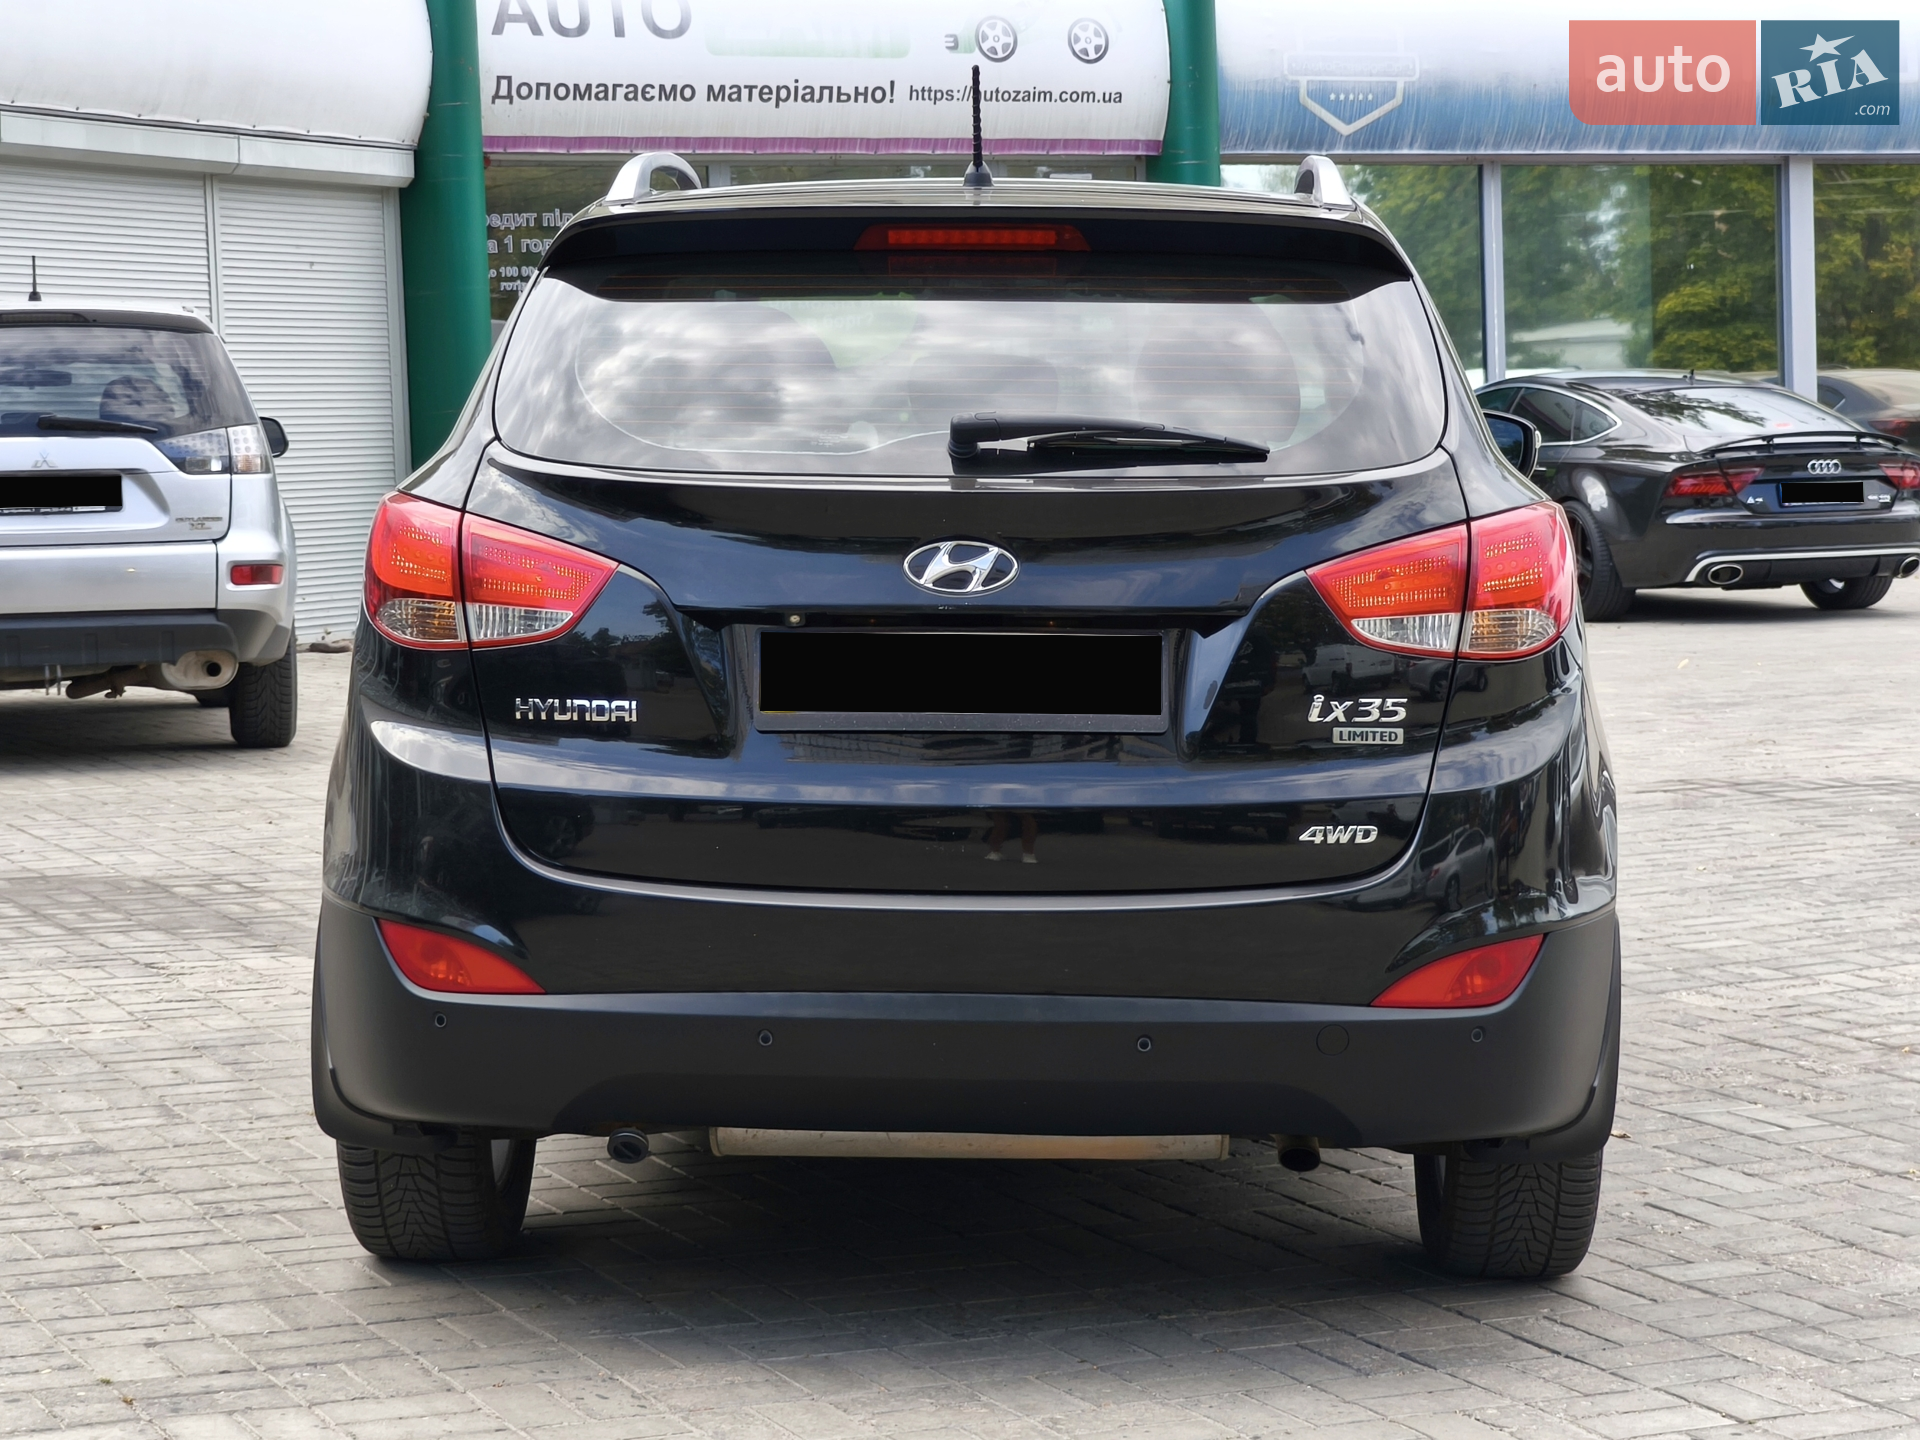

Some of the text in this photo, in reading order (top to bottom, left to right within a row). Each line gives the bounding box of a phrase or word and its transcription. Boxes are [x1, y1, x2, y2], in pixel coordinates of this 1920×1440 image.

[491, 75, 1122, 109] Допомагаємо матеріально! https://utozaim.com.ua
[486, 213, 537, 230] едит
[504, 235, 513, 253] 1
[515, 697, 638, 722] HYUNDAI
[1308, 694, 1408, 722] ix35
[1339, 731, 1398, 742] LIMITED
[1299, 825, 1378, 844] 4WD
